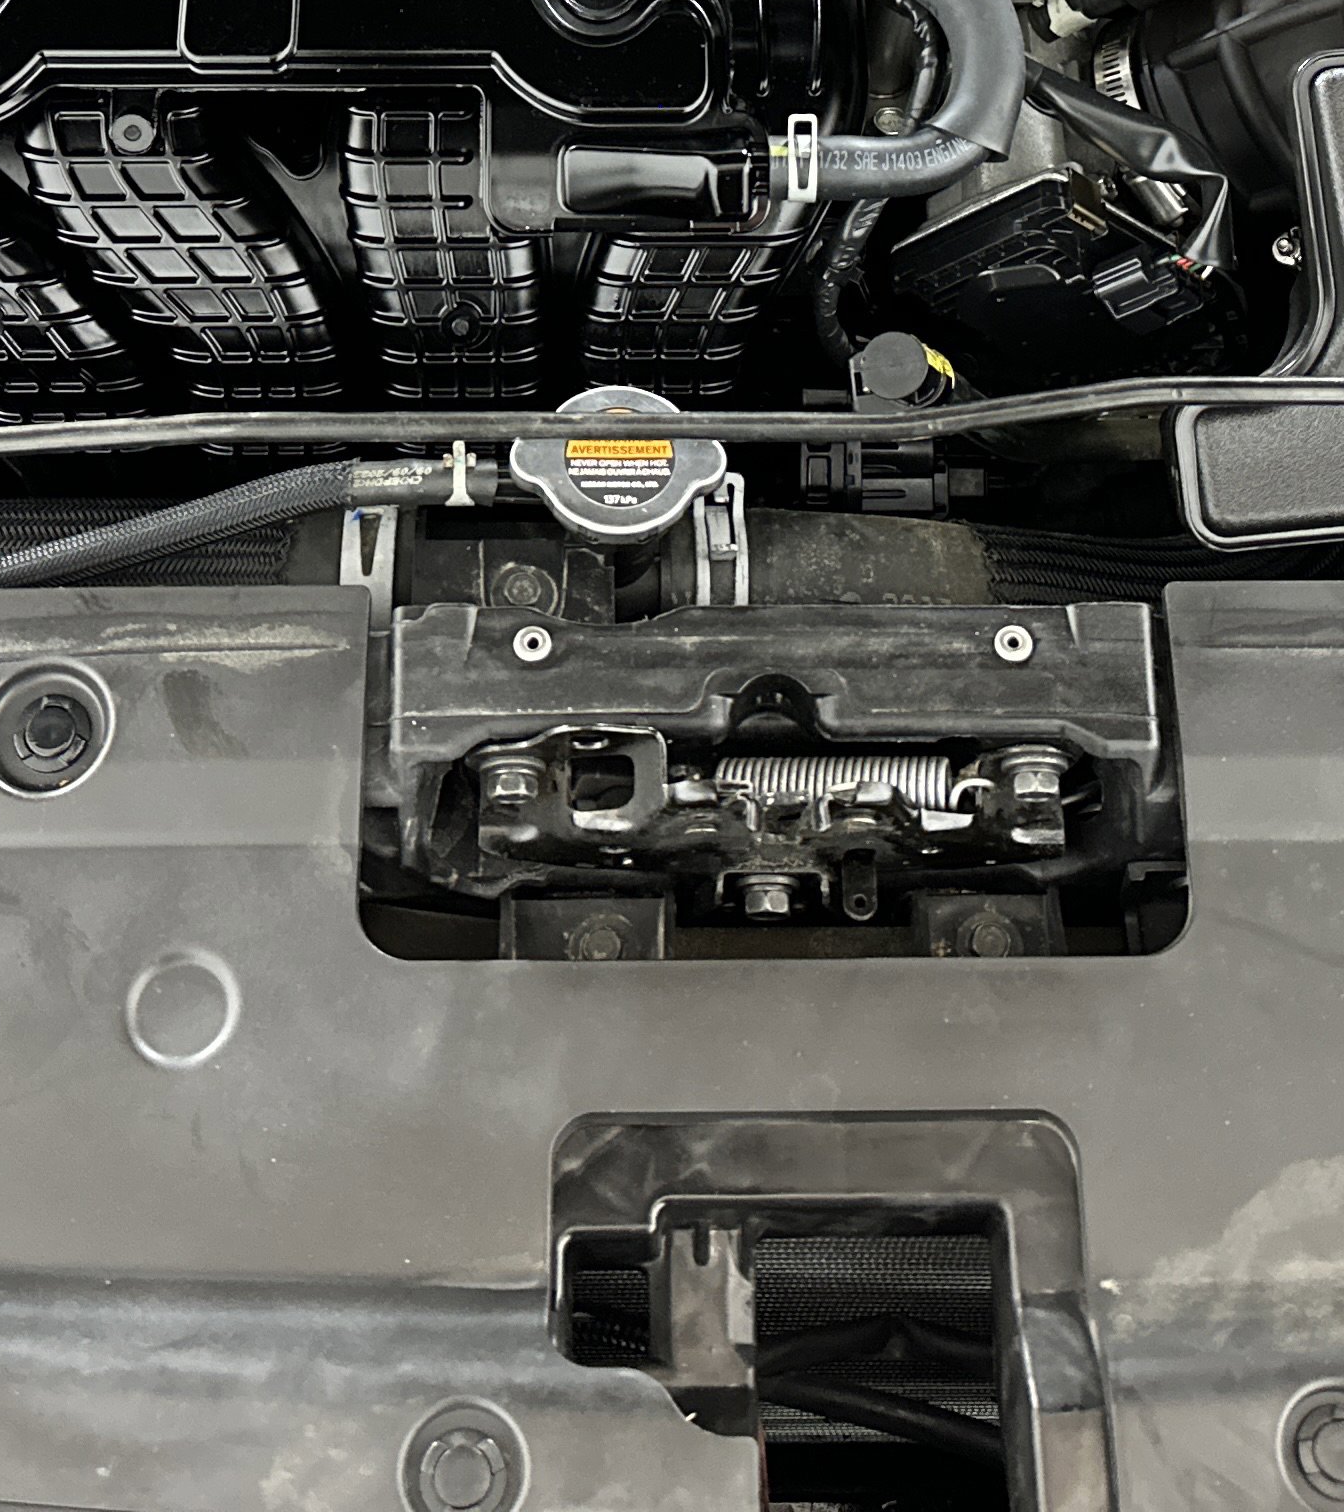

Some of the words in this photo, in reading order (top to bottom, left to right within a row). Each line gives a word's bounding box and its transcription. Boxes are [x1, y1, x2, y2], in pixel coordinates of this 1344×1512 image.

[854, 151, 878, 170] SAE
[881, 151, 923, 170] J1403
[571, 445, 667, 455] AVERTISSEMENT
[603, 495, 620, 503] 137
